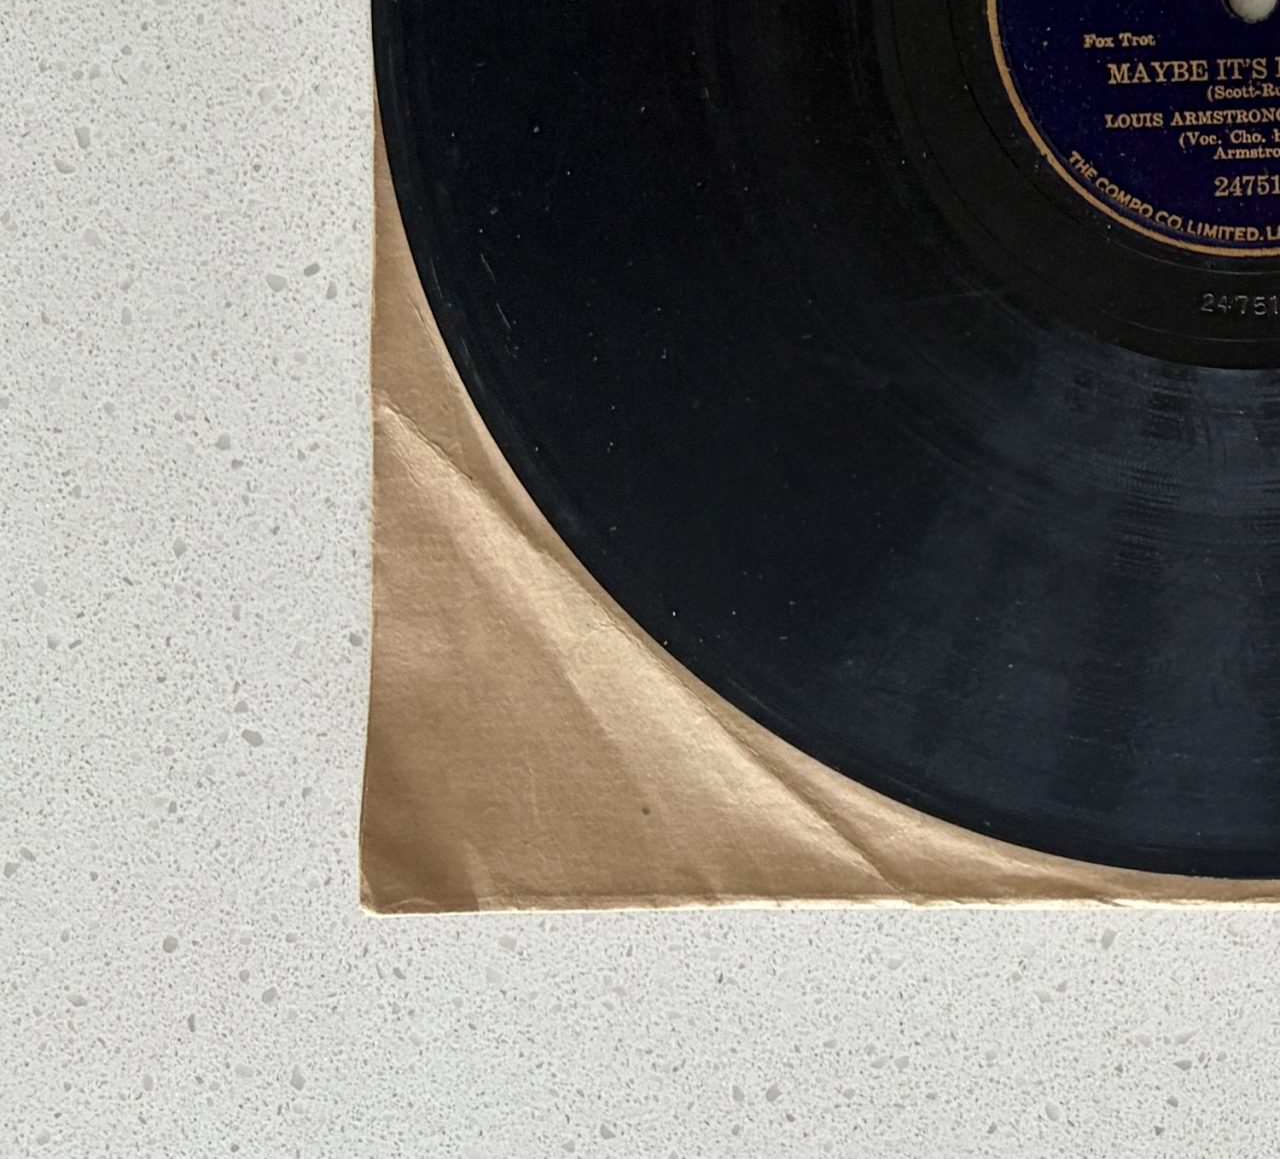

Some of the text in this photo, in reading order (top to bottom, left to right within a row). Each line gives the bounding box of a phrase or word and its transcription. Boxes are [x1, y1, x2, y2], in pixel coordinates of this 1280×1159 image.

[1083, 32, 1156, 48] Fox Trot
[1107, 59, 1209, 85] MAYBE
[1216, 57, 1268, 80] IT'S
[1104, 112, 1164, 128] LOUIS
[1179, 131, 1222, 148] (Voc.
[1229, 129, 1266, 144] Cho.
[1068, 150, 1099, 181] THE
